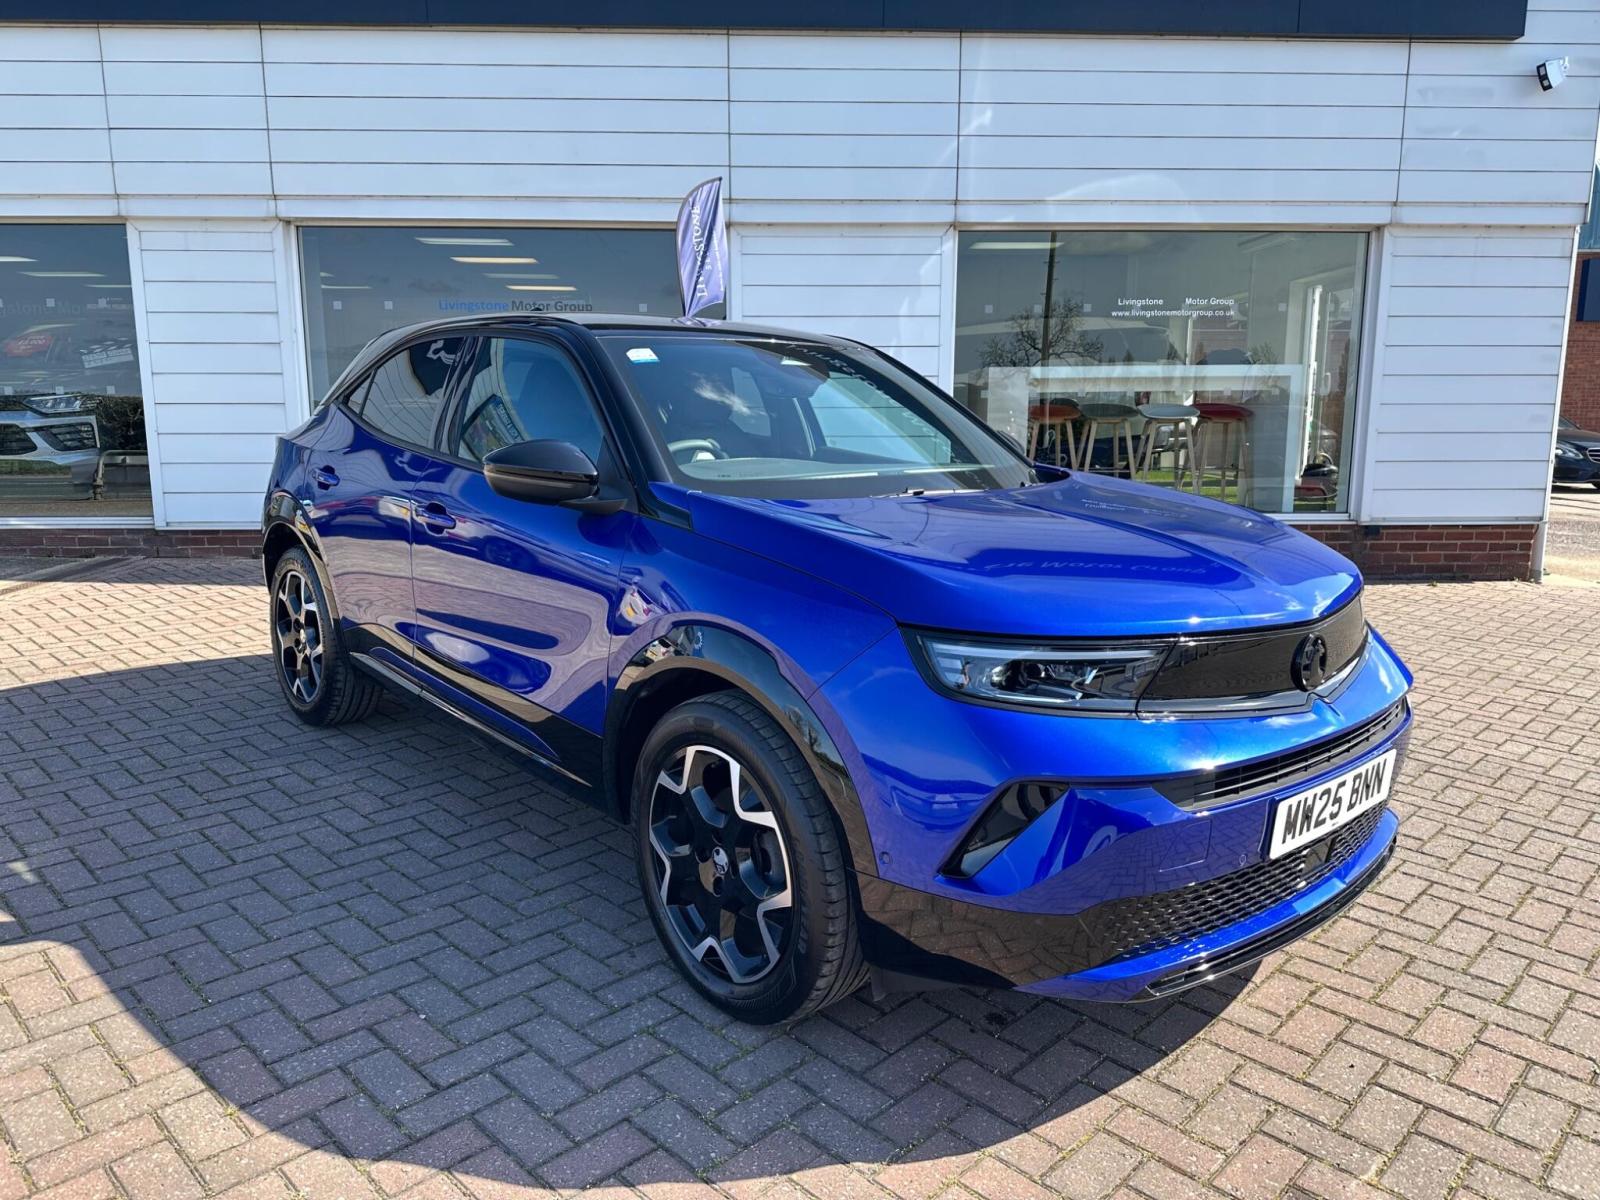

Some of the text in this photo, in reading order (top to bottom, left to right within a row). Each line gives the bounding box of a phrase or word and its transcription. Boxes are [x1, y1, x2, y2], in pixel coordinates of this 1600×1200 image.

[439, 300, 593, 313] Livingstone Motor Group
[1117, 297, 1235, 307] Livingstone Motor Group
[1111, 308, 1235, 318] www.livingstonemotorgroup.co.uk
[1281, 758, 1388, 845] MW25 BNN
